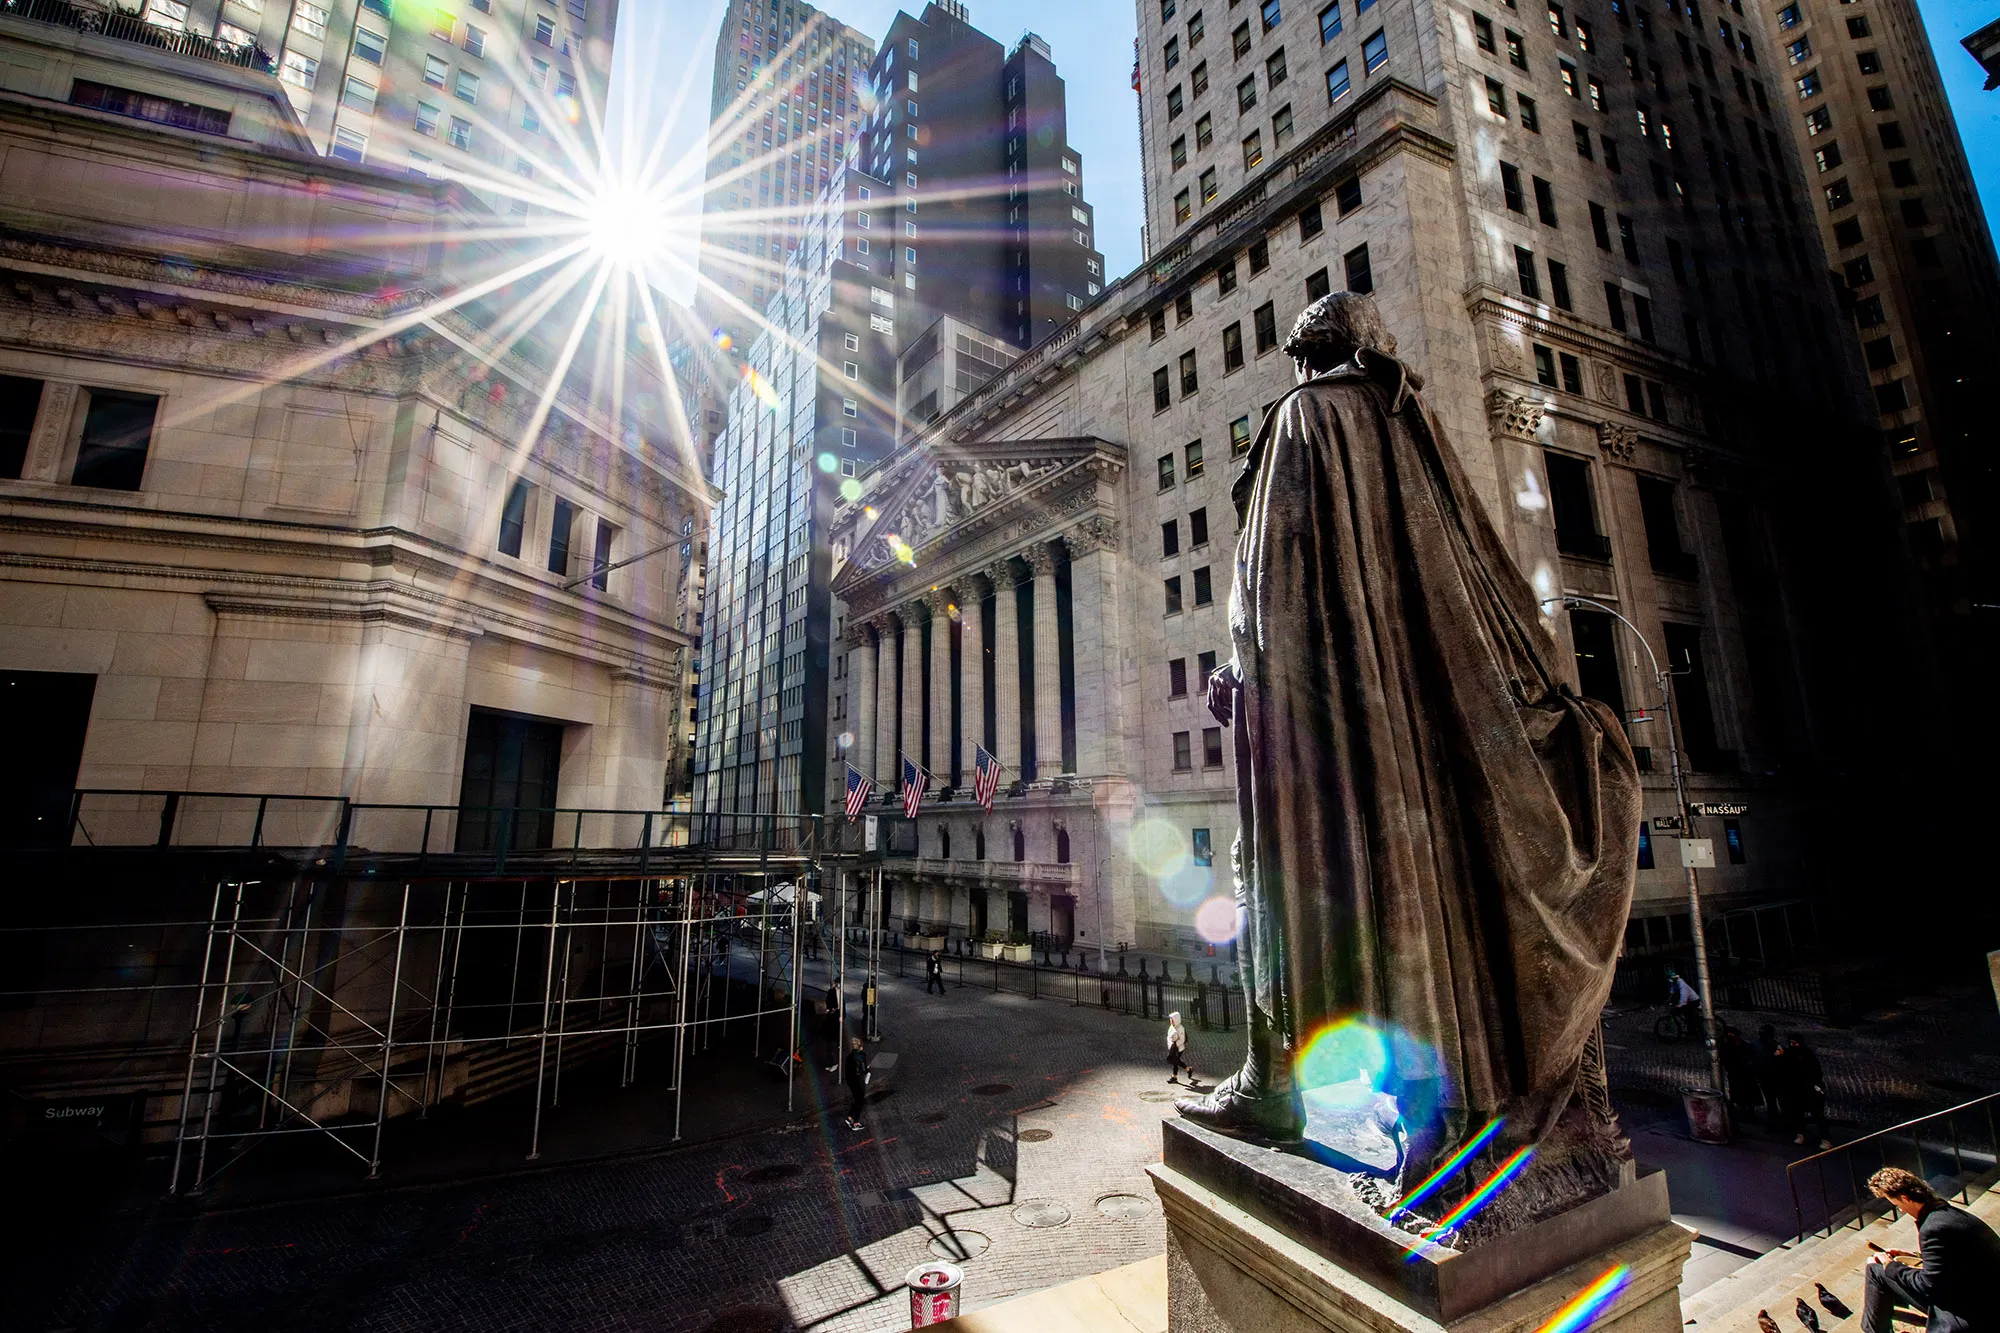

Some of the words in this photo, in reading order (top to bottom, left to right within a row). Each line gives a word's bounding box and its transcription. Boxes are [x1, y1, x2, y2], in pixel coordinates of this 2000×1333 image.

[1706, 806, 1741, 814] NASSAU
[1655, 818, 1670, 828] WALL
[44, 1106, 104, 1119] Subway
